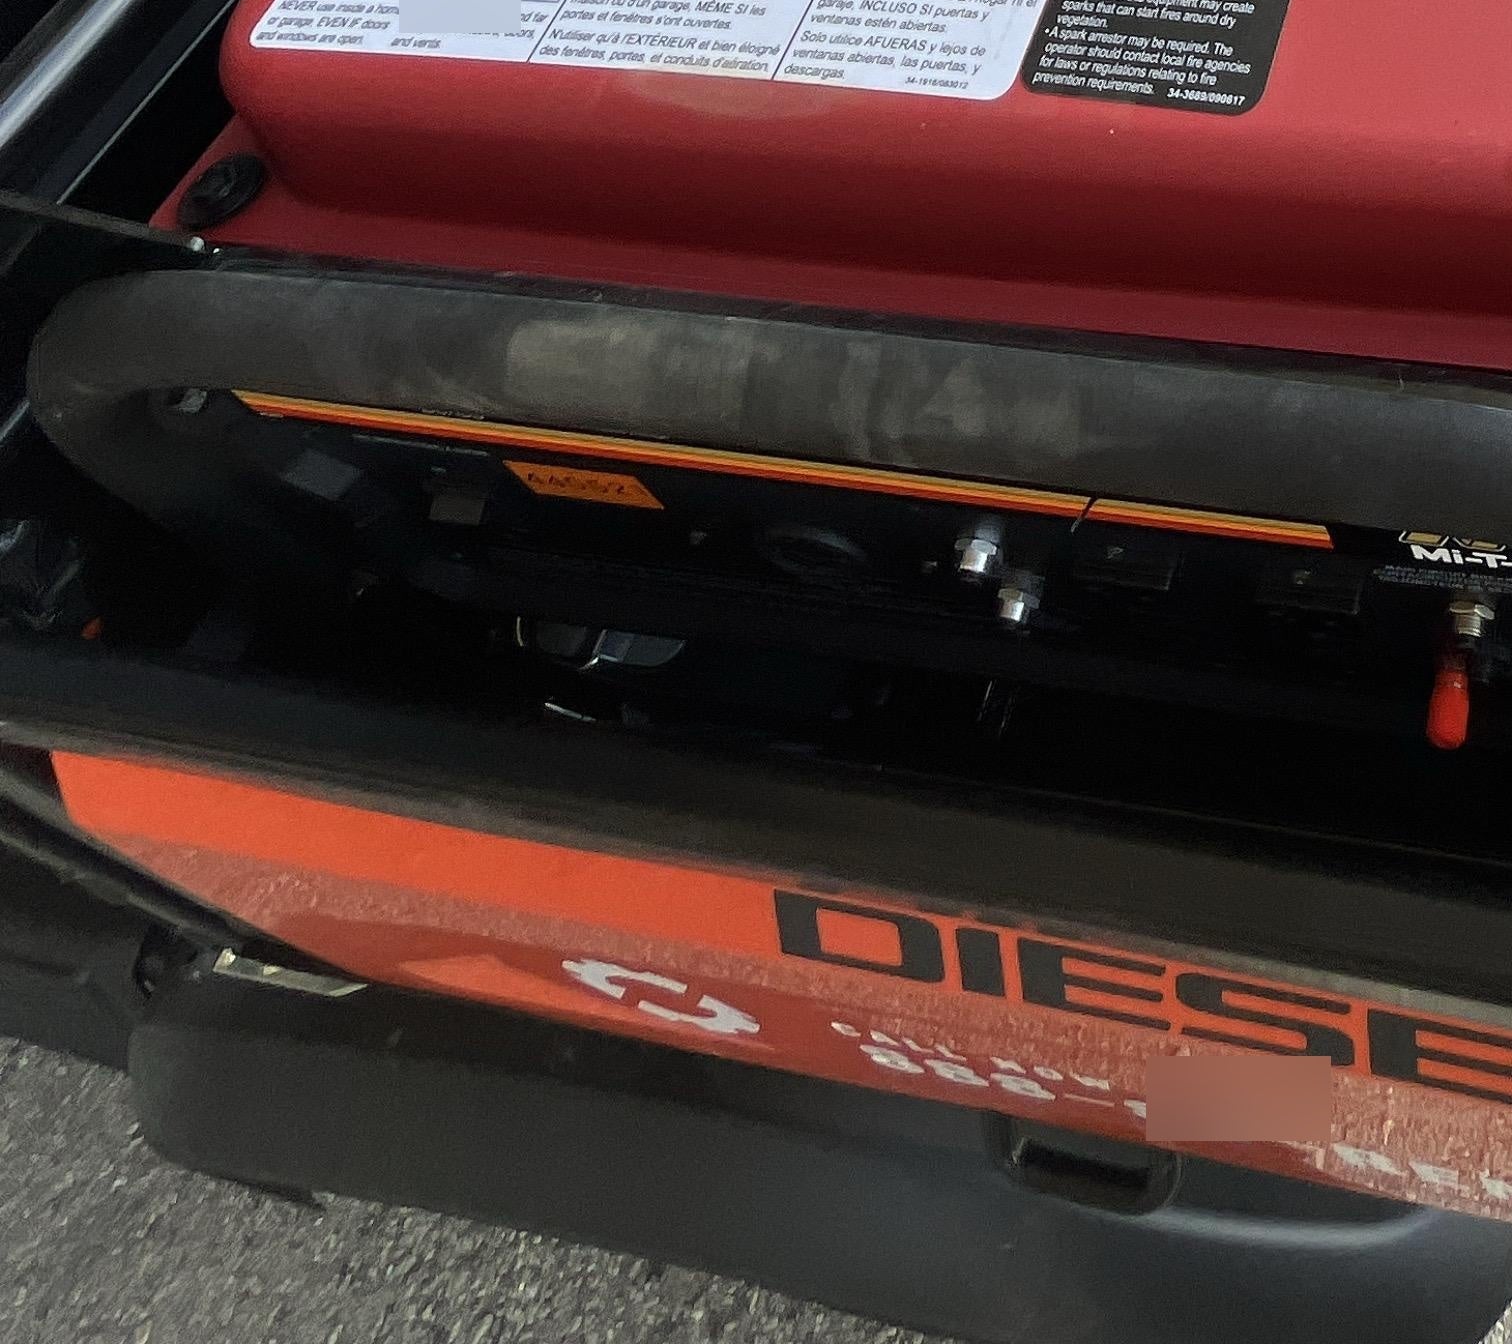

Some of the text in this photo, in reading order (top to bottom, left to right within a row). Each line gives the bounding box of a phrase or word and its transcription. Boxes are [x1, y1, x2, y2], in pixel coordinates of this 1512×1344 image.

[1060, 0, 1236, 28] sparks that can start fires around dry
[1198, 1, 1220, 12] may
[1222, 0, 1255, 13] create
[1055, 13, 1109, 29] vegetation.
[1057, 28, 1087, 42] spark
[1087, 31, 1127, 44] arrestor
[1126, 38, 1149, 49] may
[1165, 39, 1211, 55] required.
[1211, 43, 1233, 55] The
[1038, 55, 1054, 67] for
[1054, 57, 1079, 70] laws
[1090, 61, 1147, 79] regulations
[1146, 67, 1186, 83] relating
[1199, 72, 1217, 84] fire
[1043, 41, 1251, 75] operator should contact local fire agencies
[1031, 71, 1155, 95] prevention requirements.
